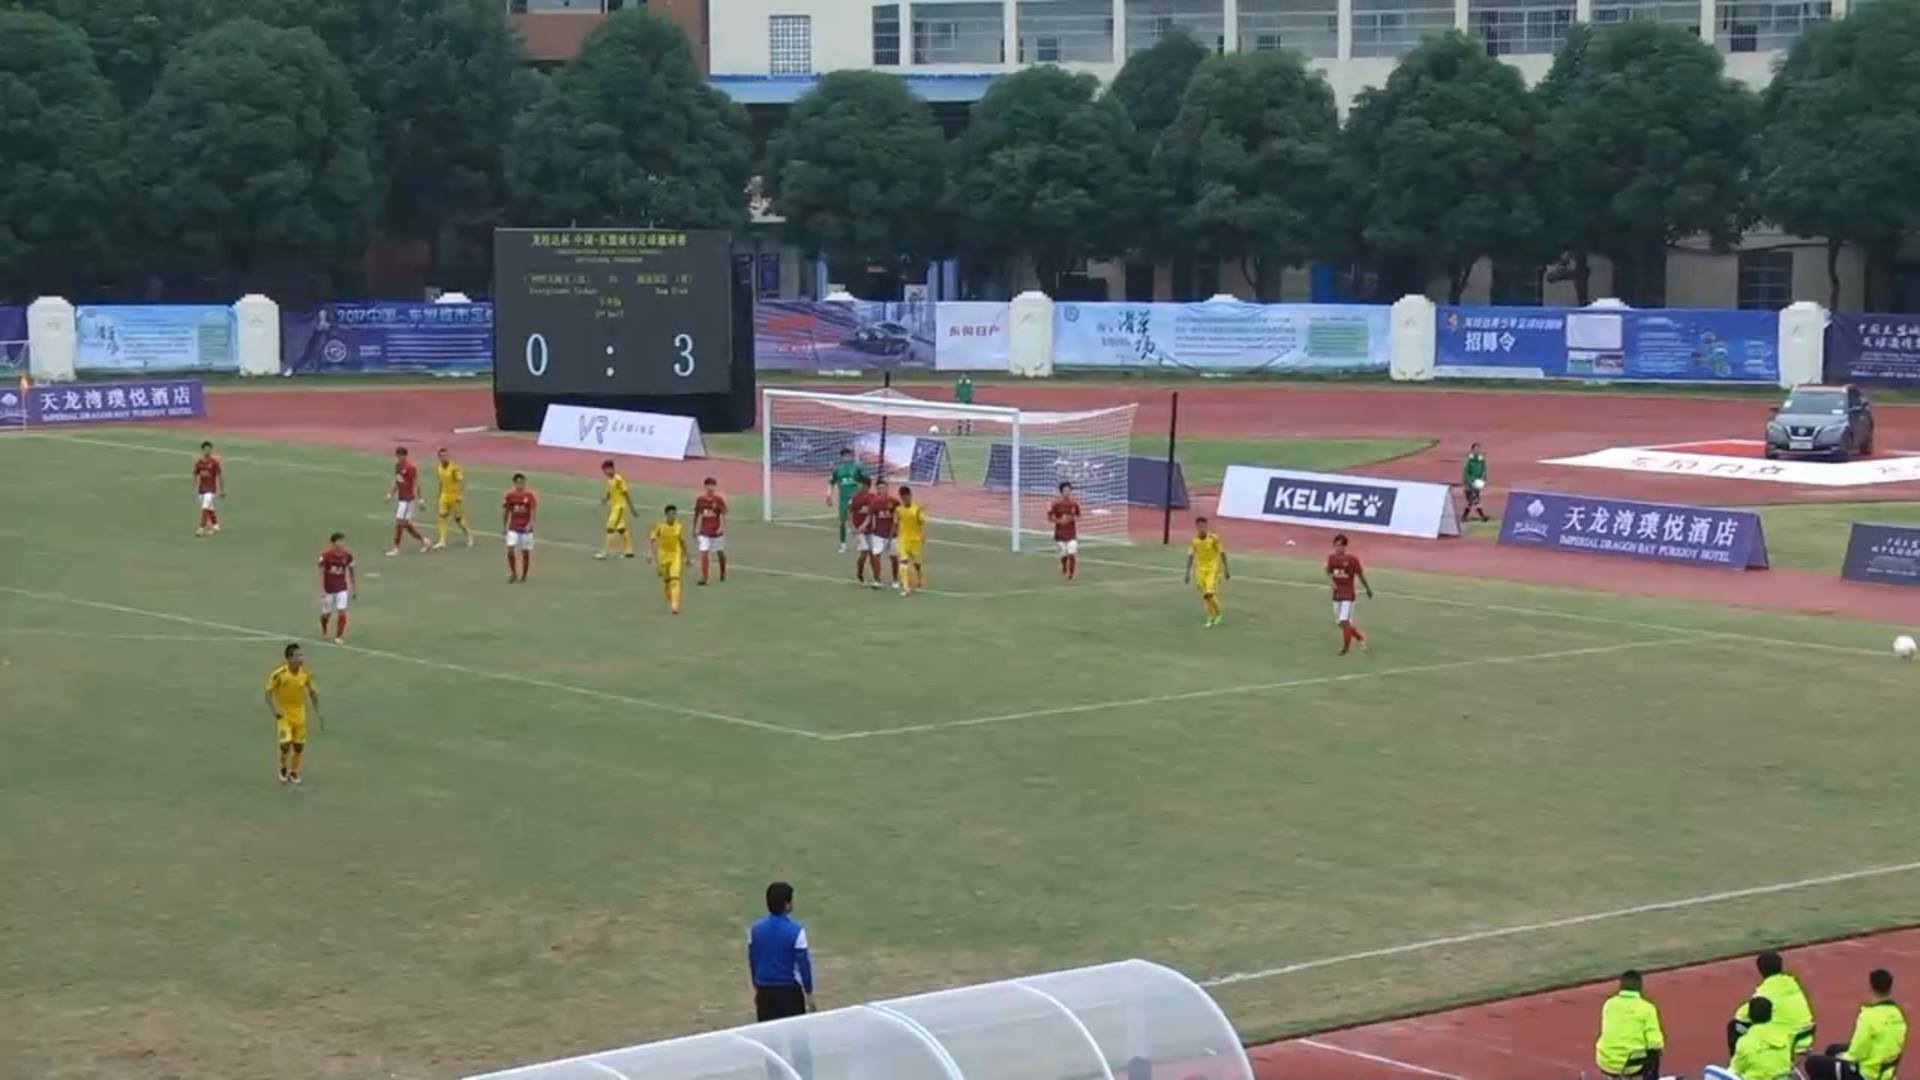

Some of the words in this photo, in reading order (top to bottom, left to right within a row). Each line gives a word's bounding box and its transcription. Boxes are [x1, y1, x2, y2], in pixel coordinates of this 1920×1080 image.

[525, 333, 548, 376] 0
[673, 333, 695, 377] 3
[1464, 331, 1516, 353] 招募令
[40, 386, 191, 411] 天龙湾璞悦酒店
[1273, 485, 1362, 516] KELME
[1561, 505, 1740, 548] 天龙湾璞悦酒店
[1558, 533, 1599, 548] IMPERIAL
[1599, 537, 1637, 553] DRAGON
[1638, 542, 1658, 555] BAY
[1699, 549, 1731, 563] HOTEL
